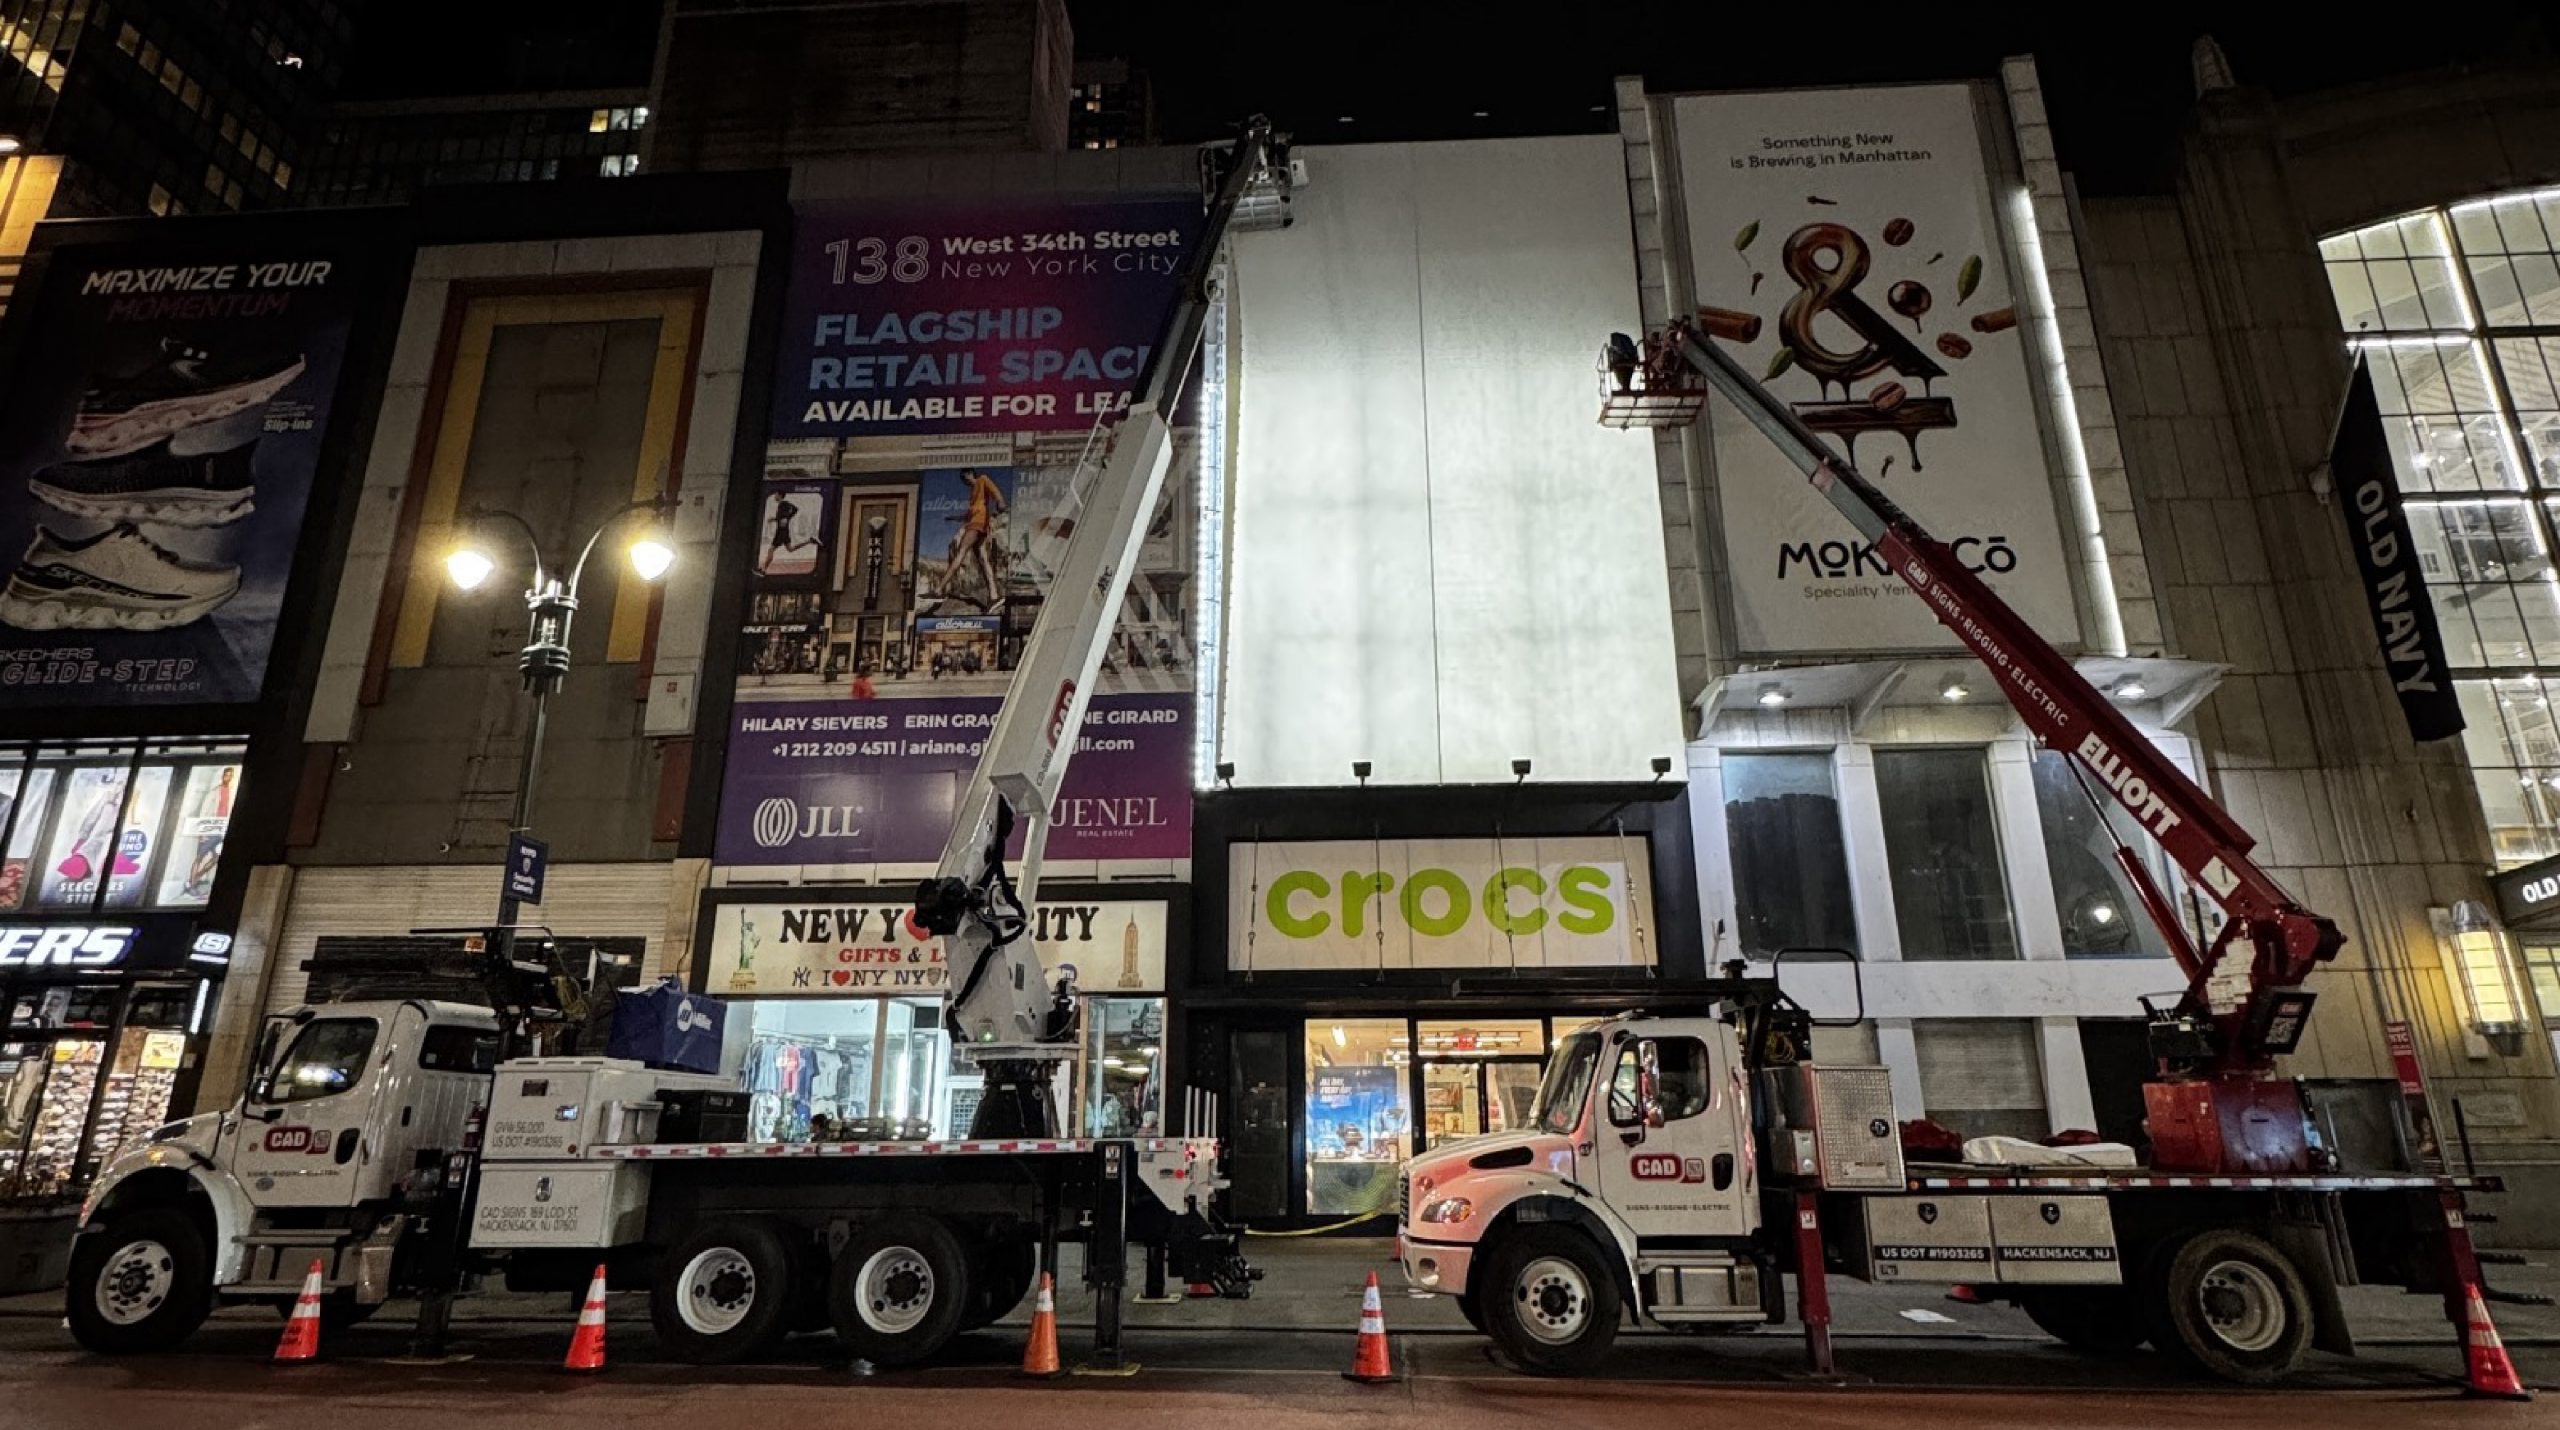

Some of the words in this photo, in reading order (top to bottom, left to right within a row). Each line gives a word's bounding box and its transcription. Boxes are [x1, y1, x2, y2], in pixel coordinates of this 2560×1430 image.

[1762, 135, 1852, 150] Something
[1856, 133, 1894, 146] New
[1730, 156, 1744, 168] is
[1748, 154, 1816, 169] Brewing
[1820, 153, 1835, 165] in
[1840, 149, 1931, 164] Manhattan
[825, 236, 929, 284] 138
[943, 236, 1014, 256] West
[1020, 231, 1086, 252] 34th
[1094, 229, 1180, 249] Street
[941, 259, 1011, 280] New
[1025, 254, 1099, 276] York
[1114, 252, 1181, 276] City
[81, 264, 239, 296] MAXIMIZE
[247, 260, 332, 288] YOUR
[106, 292, 291, 322] MOMENTUM
[813, 306, 1063, 347] FLAGSHIP
[808, 352, 986, 390] RETAIL
[802, 395, 984, 423] AVAILABLE
[991, 393, 1057, 417] FOR
[1075, 390, 1133, 414] LEA
[2355, 479, 2398, 568] OLD
[1804, 583, 1878, 600] Speciality
[1906, 561, 1929, 586] CAD
[1930, 583, 1961, 619] SIGNS
[1962, 617, 2009, 667] RIGGING
[2010, 666, 2069, 727] ELECTRIC
[2376, 579, 2438, 695] NAVY
[3, 658, 195, 685] GLIDE-STEP
[126, 681, 201, 692] TECHNOLOGY
[741, 715, 807, 732] HILARY
[811, 715, 888, 731] SIEVERS
[905, 714, 948, 729] ERIN
[951, 713, 1000, 728] GRAC
[1107, 709, 1178, 725] GIRARD
[772, 743, 789, 757] +1
[791, 743, 821, 756] 212
[823, 742, 856, 756] 209
[860, 740, 897, 755] 4511
[2076, 731, 2182, 837] ELLIOTT
[799, 805, 860, 838] JLL
[1049, 797, 1167, 827] JENEL
[1076, 829, 1100, 838] REAL
[1102, 829, 1135, 838] ESTATE
[59, 881, 125, 893] SKECRS
[2522, 877, 2558, 904] OLD
[1266, 867, 1614, 939] crocs
[779, 908, 870, 944] NEW
[1031, 907, 1100, 942] ITY
[0, 926, 133, 965] ERS
[838, 947, 901, 964] GIFTS
[907, 946, 922, 962] &
[851, 970, 888, 986] NY
[271, 1130, 307, 1147] CAD
[1636, 1158, 1677, 1176] CAD
[1881, 1247, 1899, 1259] US
[1901, 1247, 1925, 1259] DOT
[2095, 1248, 2110, 1259] NJ
